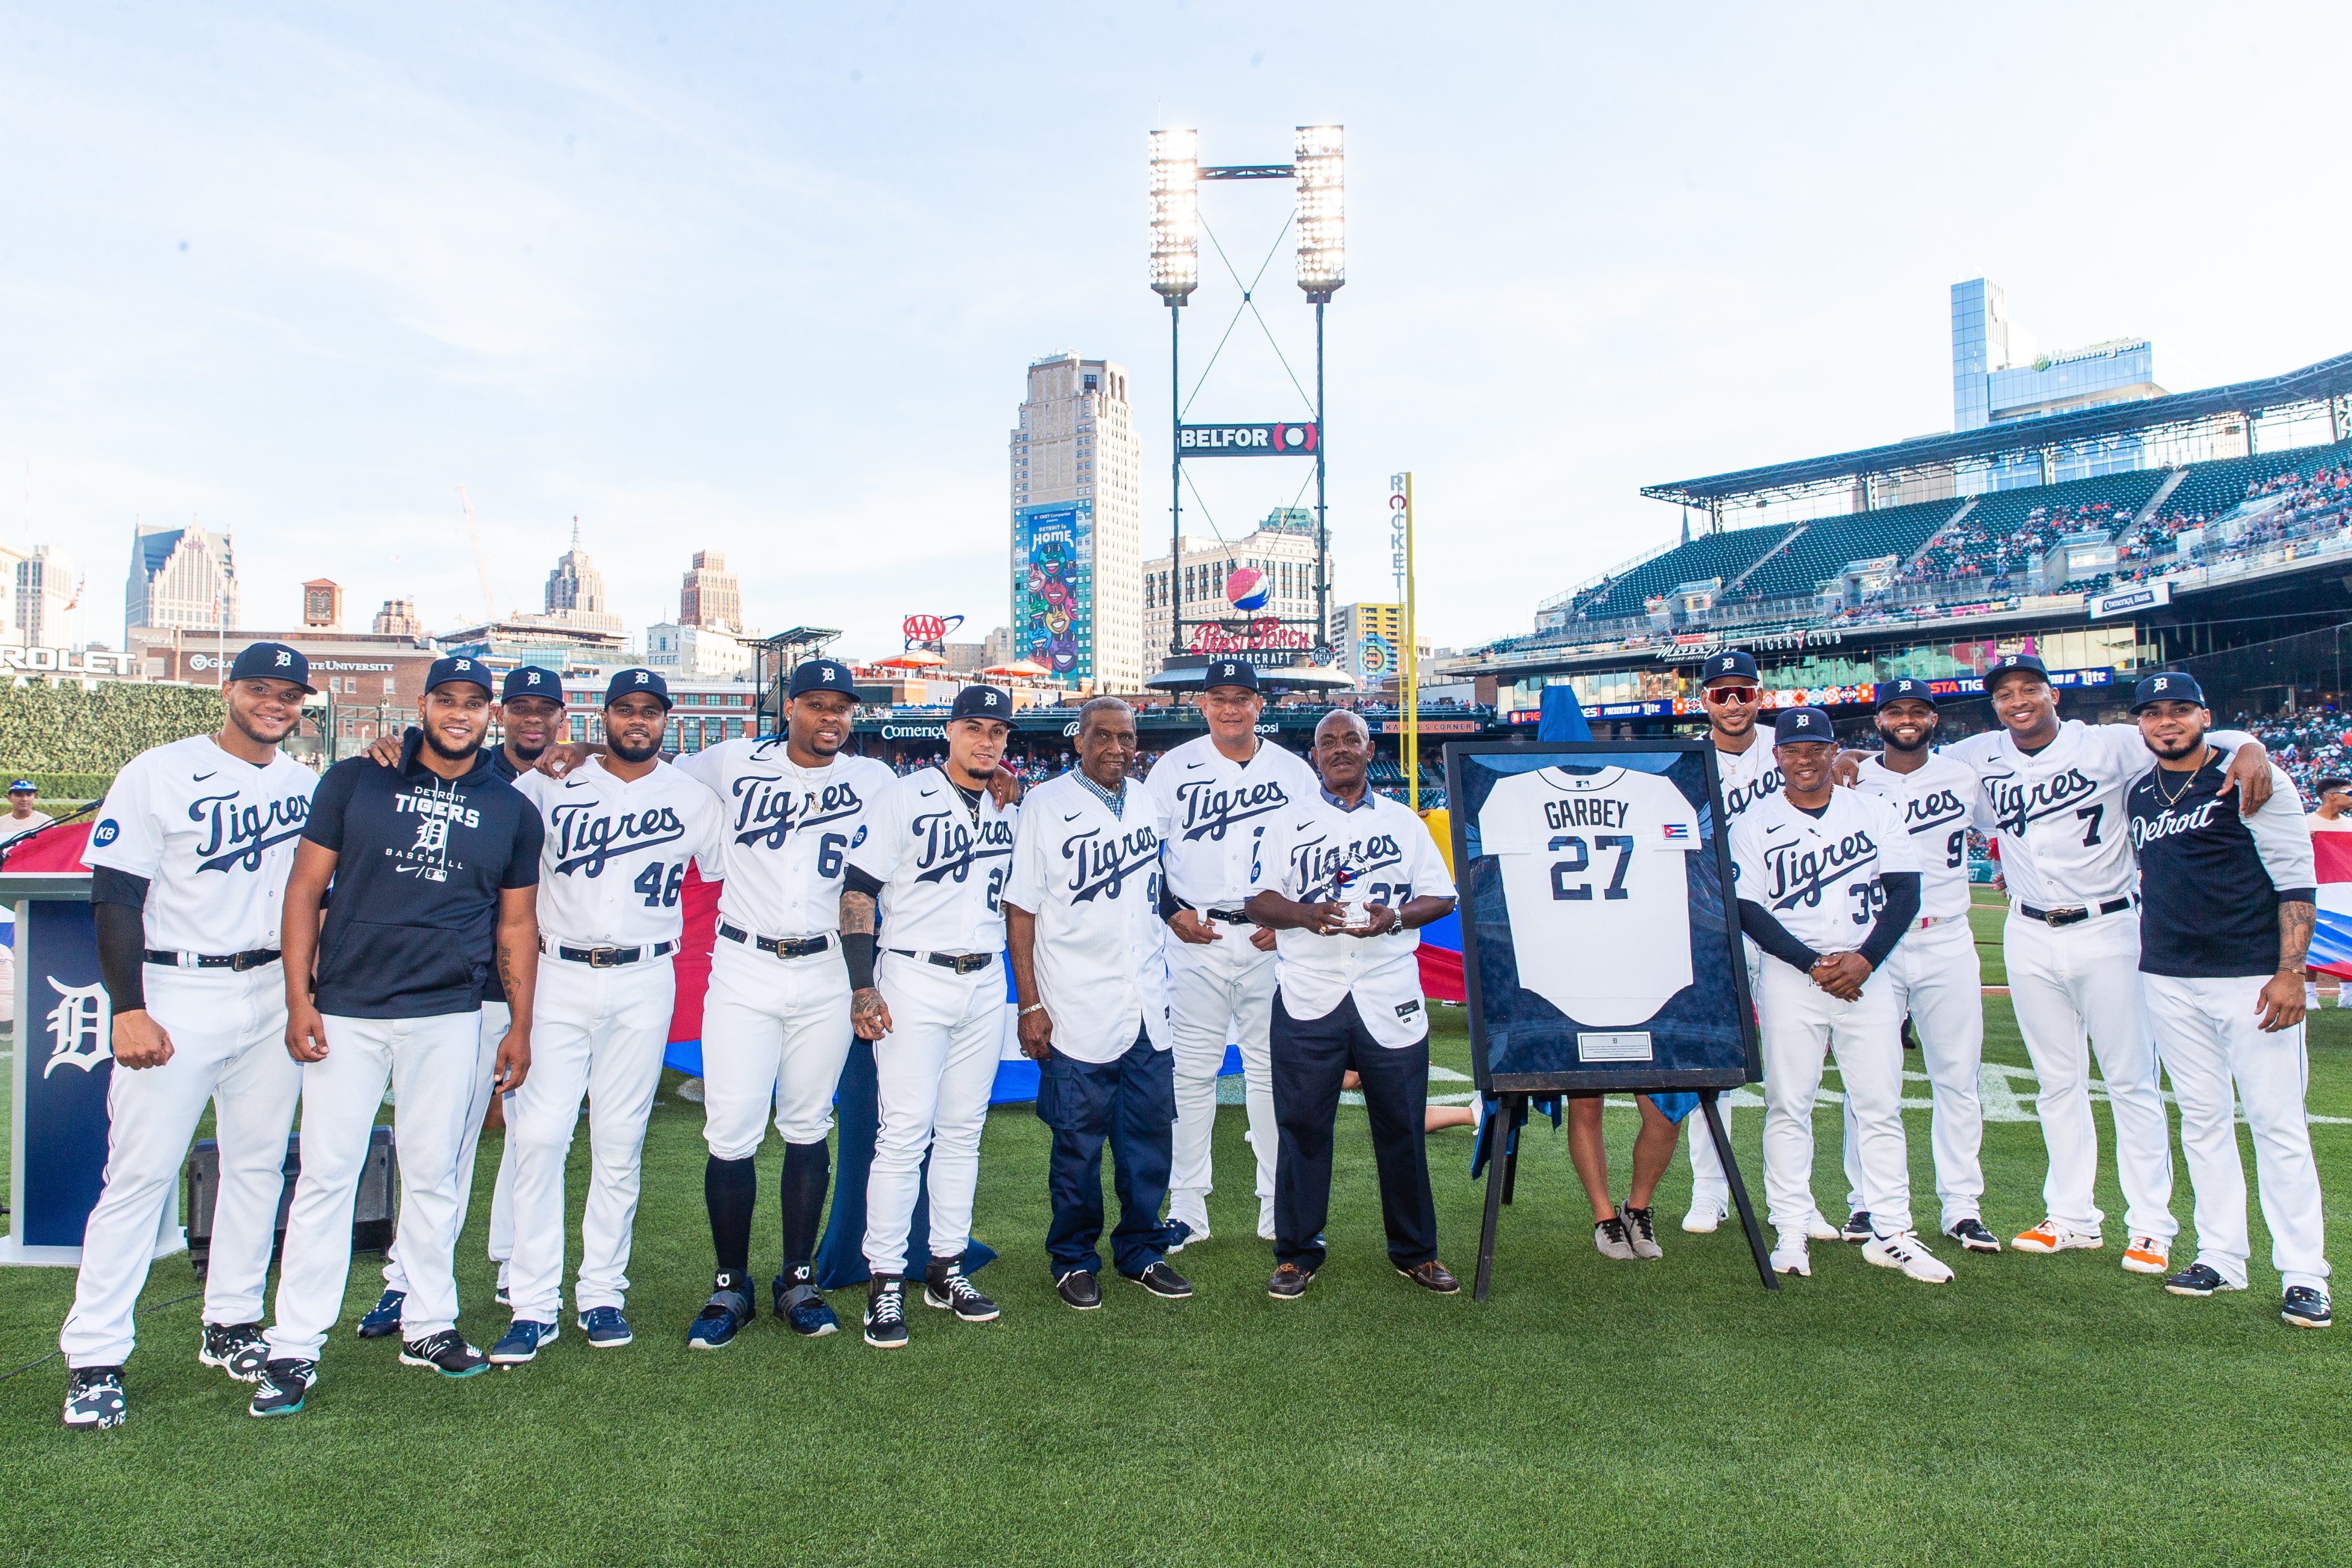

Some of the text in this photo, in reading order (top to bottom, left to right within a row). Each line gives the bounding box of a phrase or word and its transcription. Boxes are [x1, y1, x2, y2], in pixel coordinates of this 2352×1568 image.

[2052, 337, 2144, 365] Huntington
[1181, 428, 1268, 448] BELFOR
[2134, 593, 2151, 603] Bank
[907, 620, 943, 638] AAA
[1752, 632, 1842, 651] TIGER CLUB
[2081, 671, 2106, 686] Lite
[1253, 723, 1279, 734] epsi
[1604, 706, 1632, 715] PRESENTED
[1632, 706, 1640, 714] BY
[1643, 703, 1661, 715] Lite
[395, 793, 481, 828] TIGERS
[414, 785, 467, 802] DETROIT
[732, 776, 863, 850] Tigres
[1177, 778, 1289, 842] Tigres
[1544, 799, 1629, 830] GARBEY
[1982, 768, 2098, 838] Tigres
[96, 826, 115, 840] KB
[188, 790, 311, 874] Tigres
[551, 800, 685, 878] Tigres
[2076, 803, 2103, 847] 7
[2132, 799, 2223, 851] Detroit
[386, 848, 463, 870] BASEBALL
[818, 833, 848, 879] 6
[912, 810, 1012, 884] Tigres
[1062, 824, 1159, 907] Tigres
[1548, 835, 1634, 901] 27
[1947, 830, 1964, 869] 9
[634, 862, 683, 908] 46
[987, 867, 1003, 912] 2
[1764, 830, 1878, 912] Tigres
[1148, 873, 1162, 915] 4
[1848, 879, 1884, 925] 39
[44, 975, 114, 1079] D
[885, 1282, 900, 1291] NIKE
[946, 1265, 962, 1276] NIKE
